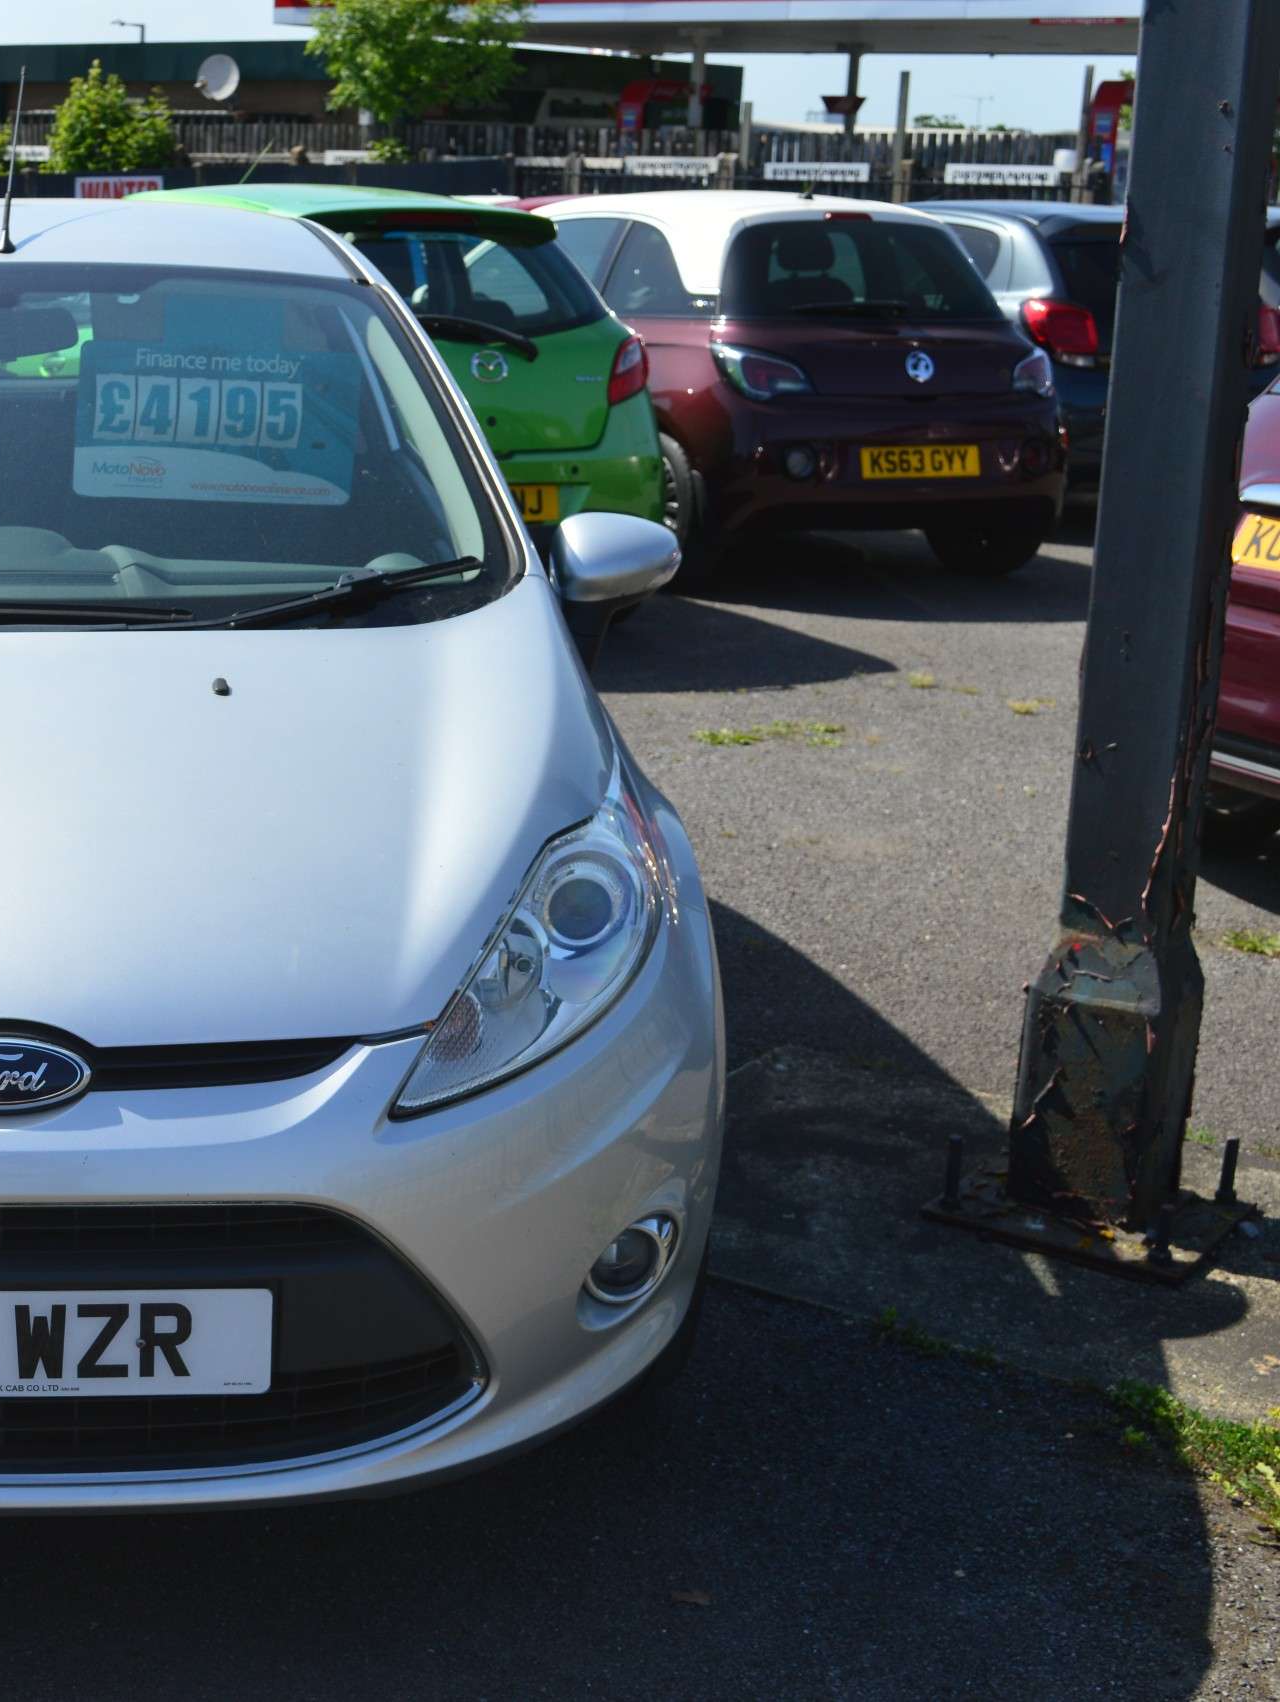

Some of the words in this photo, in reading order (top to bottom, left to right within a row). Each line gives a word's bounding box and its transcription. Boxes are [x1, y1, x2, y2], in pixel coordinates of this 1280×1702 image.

[136, 350, 207, 370] Finance
[212, 357, 241, 372] me
[96, 380, 300, 442] £4195
[92, 460, 168, 478] MotoNovo
[869, 448, 926, 474] KS63
[930, 448, 969, 473] GYY
[15, 1302, 192, 1379] WZR
[6, 1384, 24, 1392] CAB
[27, 1384, 39, 1392] CO
[42, 1384, 59, 1392] LTD
